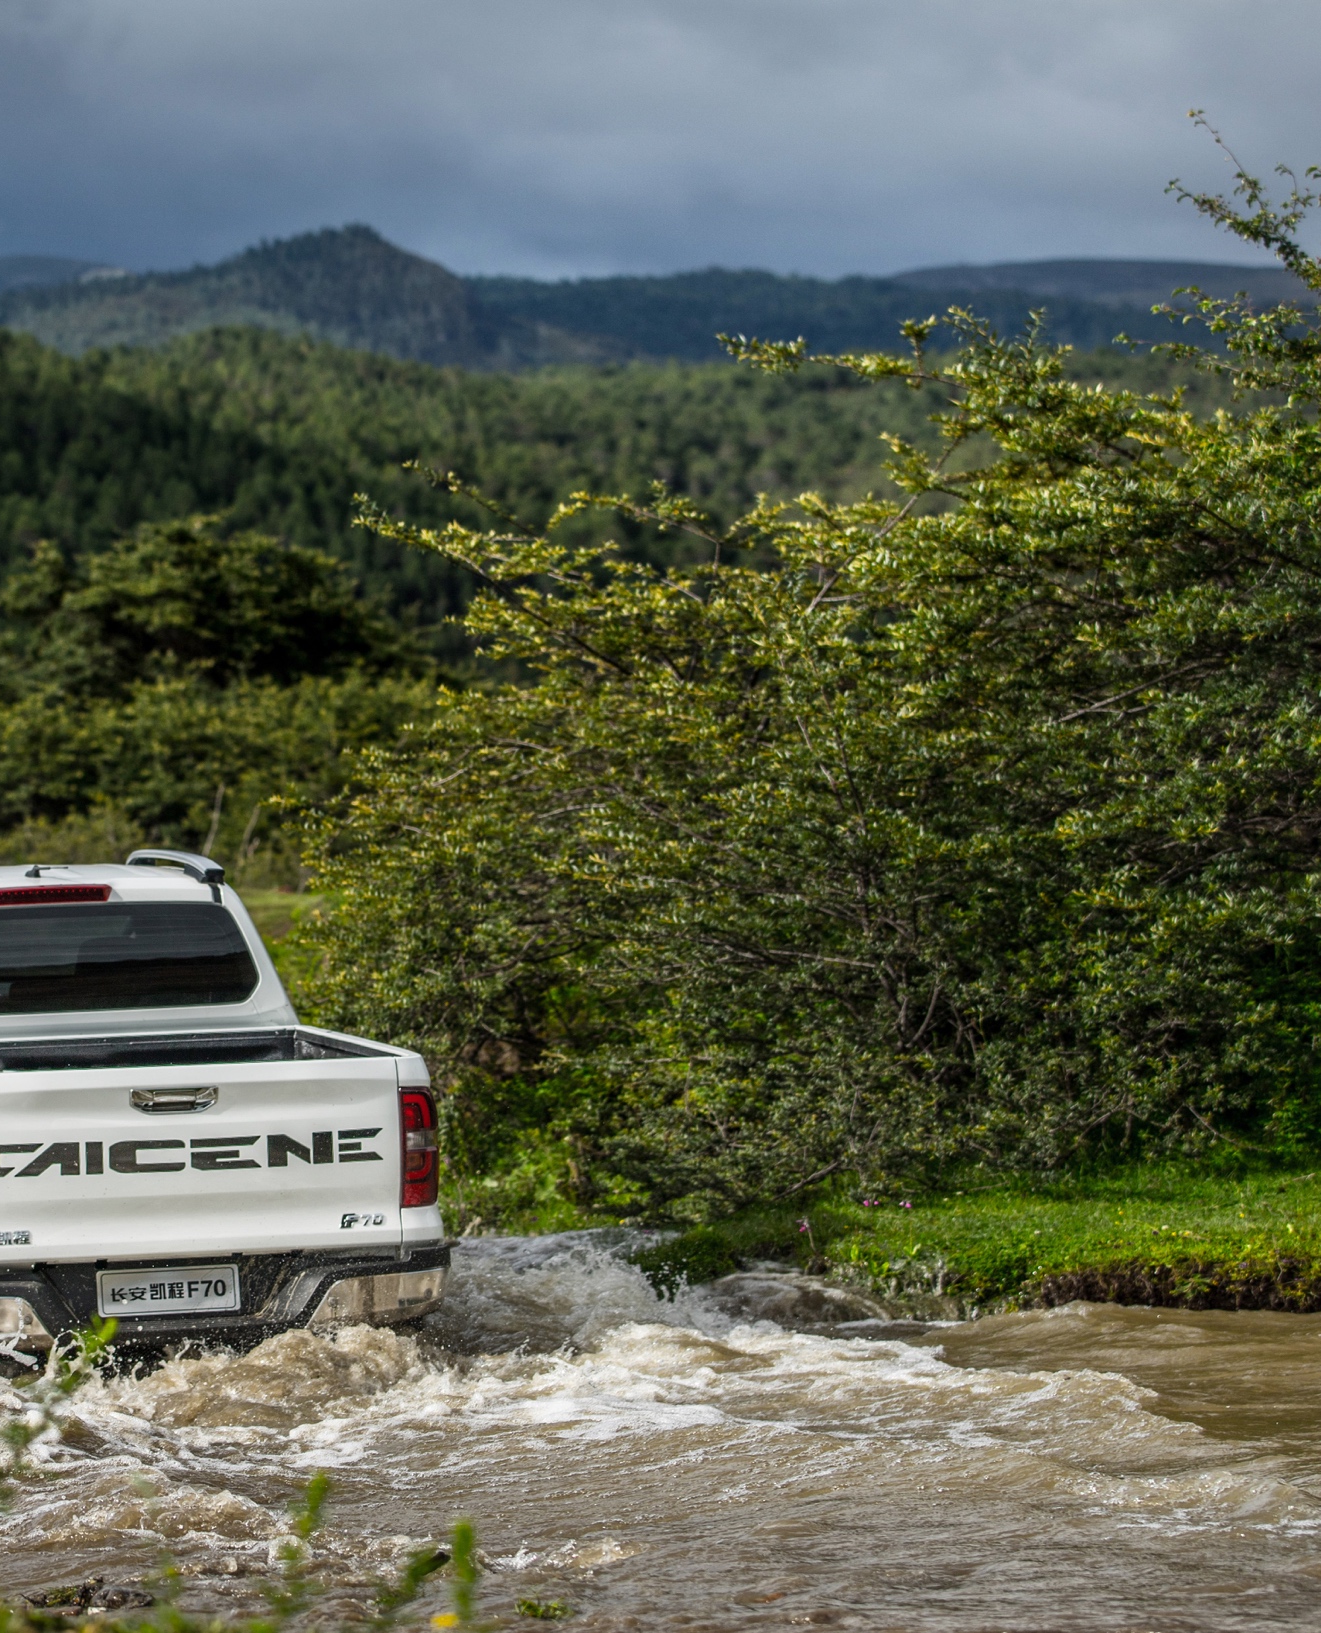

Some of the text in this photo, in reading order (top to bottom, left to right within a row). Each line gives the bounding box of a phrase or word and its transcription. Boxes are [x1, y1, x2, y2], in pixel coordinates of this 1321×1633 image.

[340, 1213, 385, 1229] F70
[110, 1279, 227, 1303] 长安凯程F70
